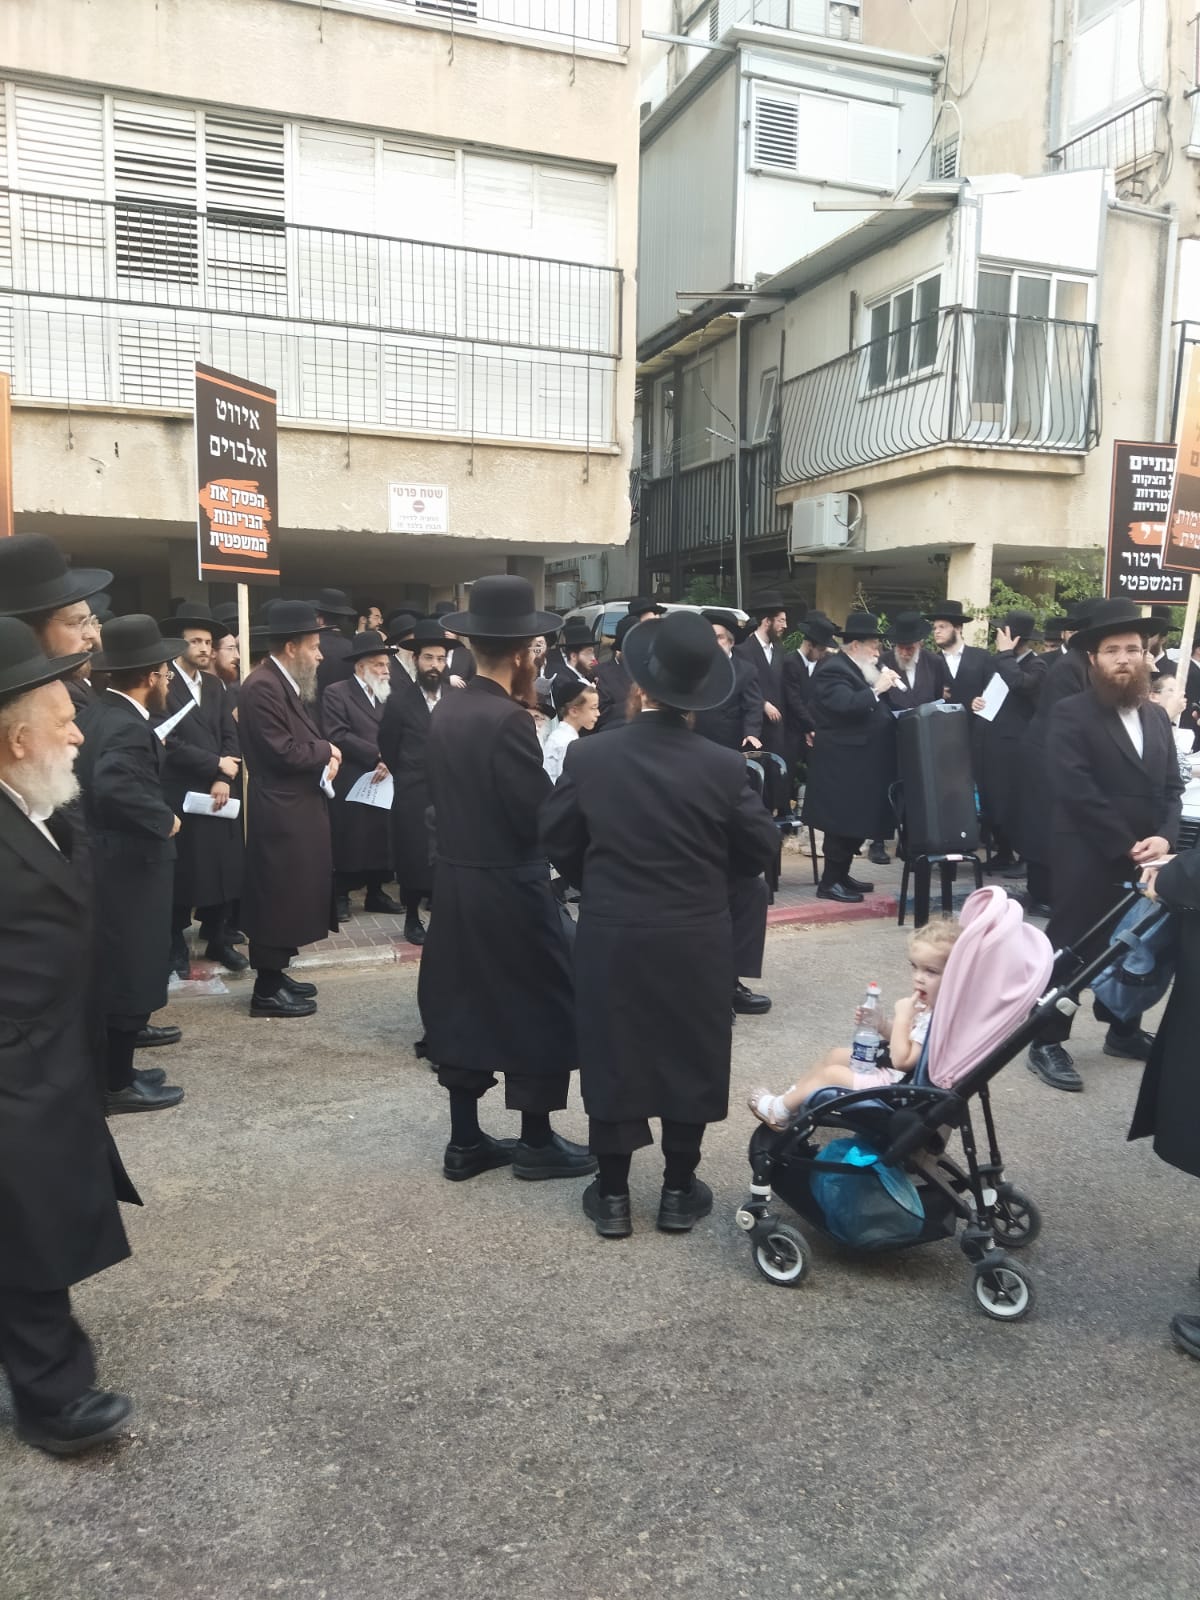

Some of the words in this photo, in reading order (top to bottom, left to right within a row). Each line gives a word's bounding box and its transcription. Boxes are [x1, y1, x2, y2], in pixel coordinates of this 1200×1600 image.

[215, 397, 260, 431] איווט
[209, 434, 268, 468] אלבוים
[1131, 473, 1166, 487] הצקות
[209, 483, 229, 501] את
[231, 488, 265, 509] הפסק
[393, 487, 417, 498] פרטי
[420, 487, 443, 499] שטח
[213, 508, 263, 530] הבריונות
[209, 530, 268, 553] המשפטית
[1119, 570, 1183, 591] המשפטי
